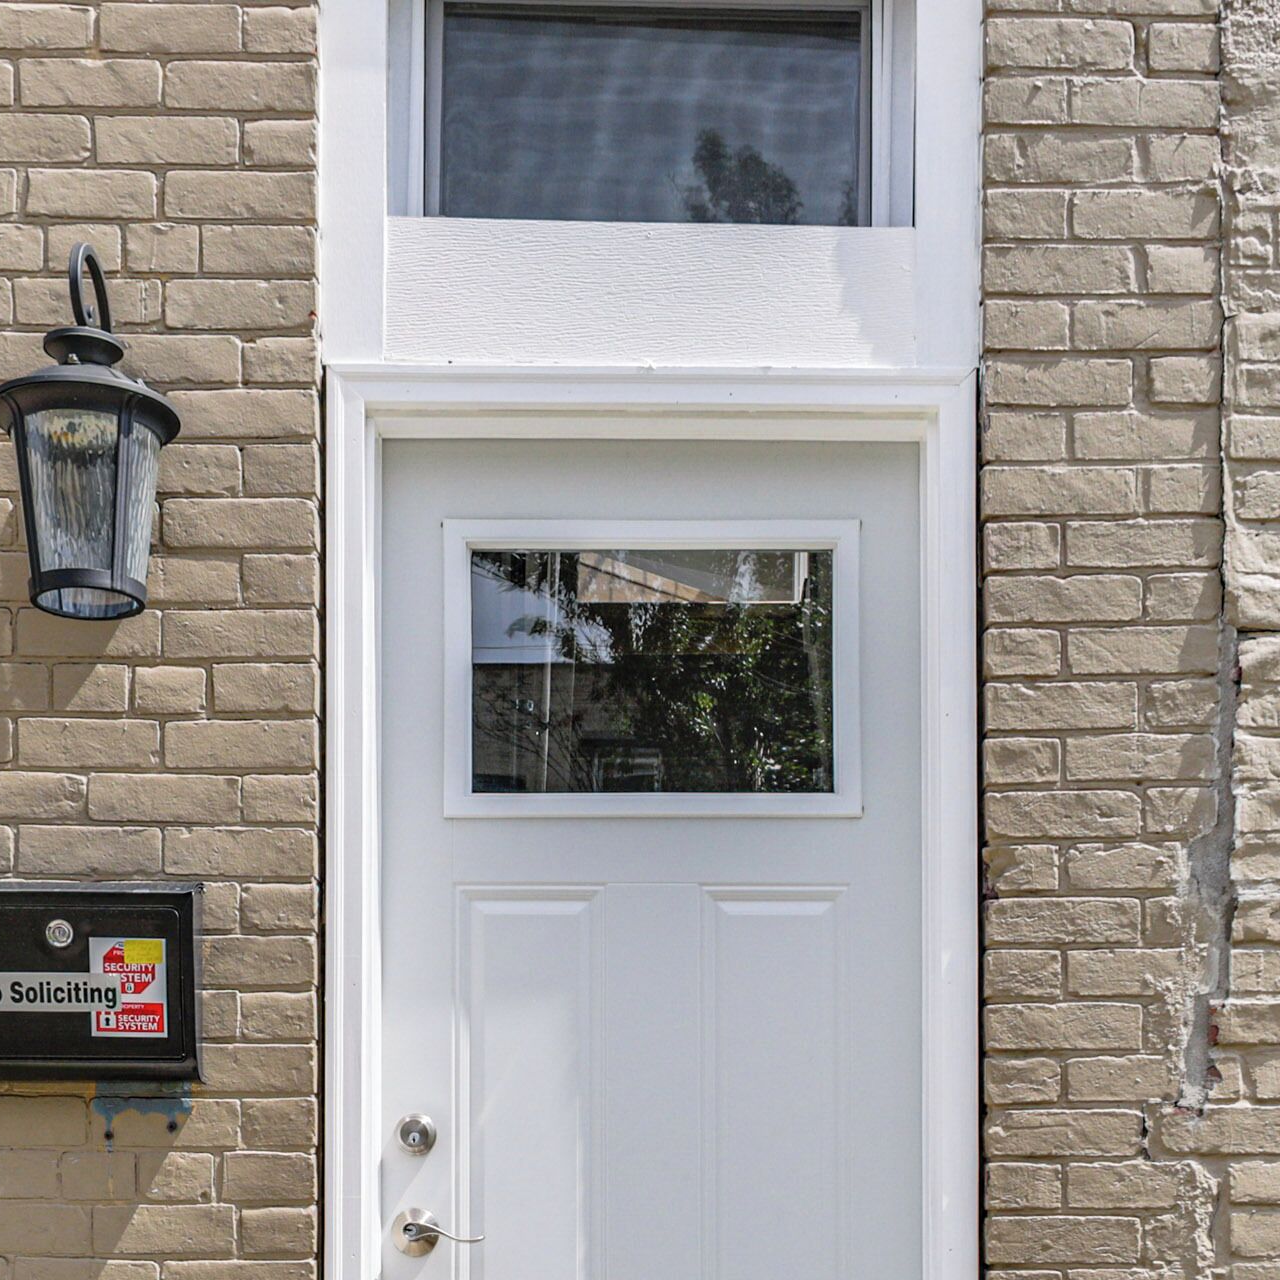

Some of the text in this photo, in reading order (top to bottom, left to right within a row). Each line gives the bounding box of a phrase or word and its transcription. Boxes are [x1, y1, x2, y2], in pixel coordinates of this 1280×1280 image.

[104, 962, 153, 972] SECURITY
[109, 973, 152, 982] STEM
[10, 980, 118, 1009] Soliciting
[118, 1014, 160, 1022] SECURITY
[118, 1022, 158, 1031] SYSTEM
